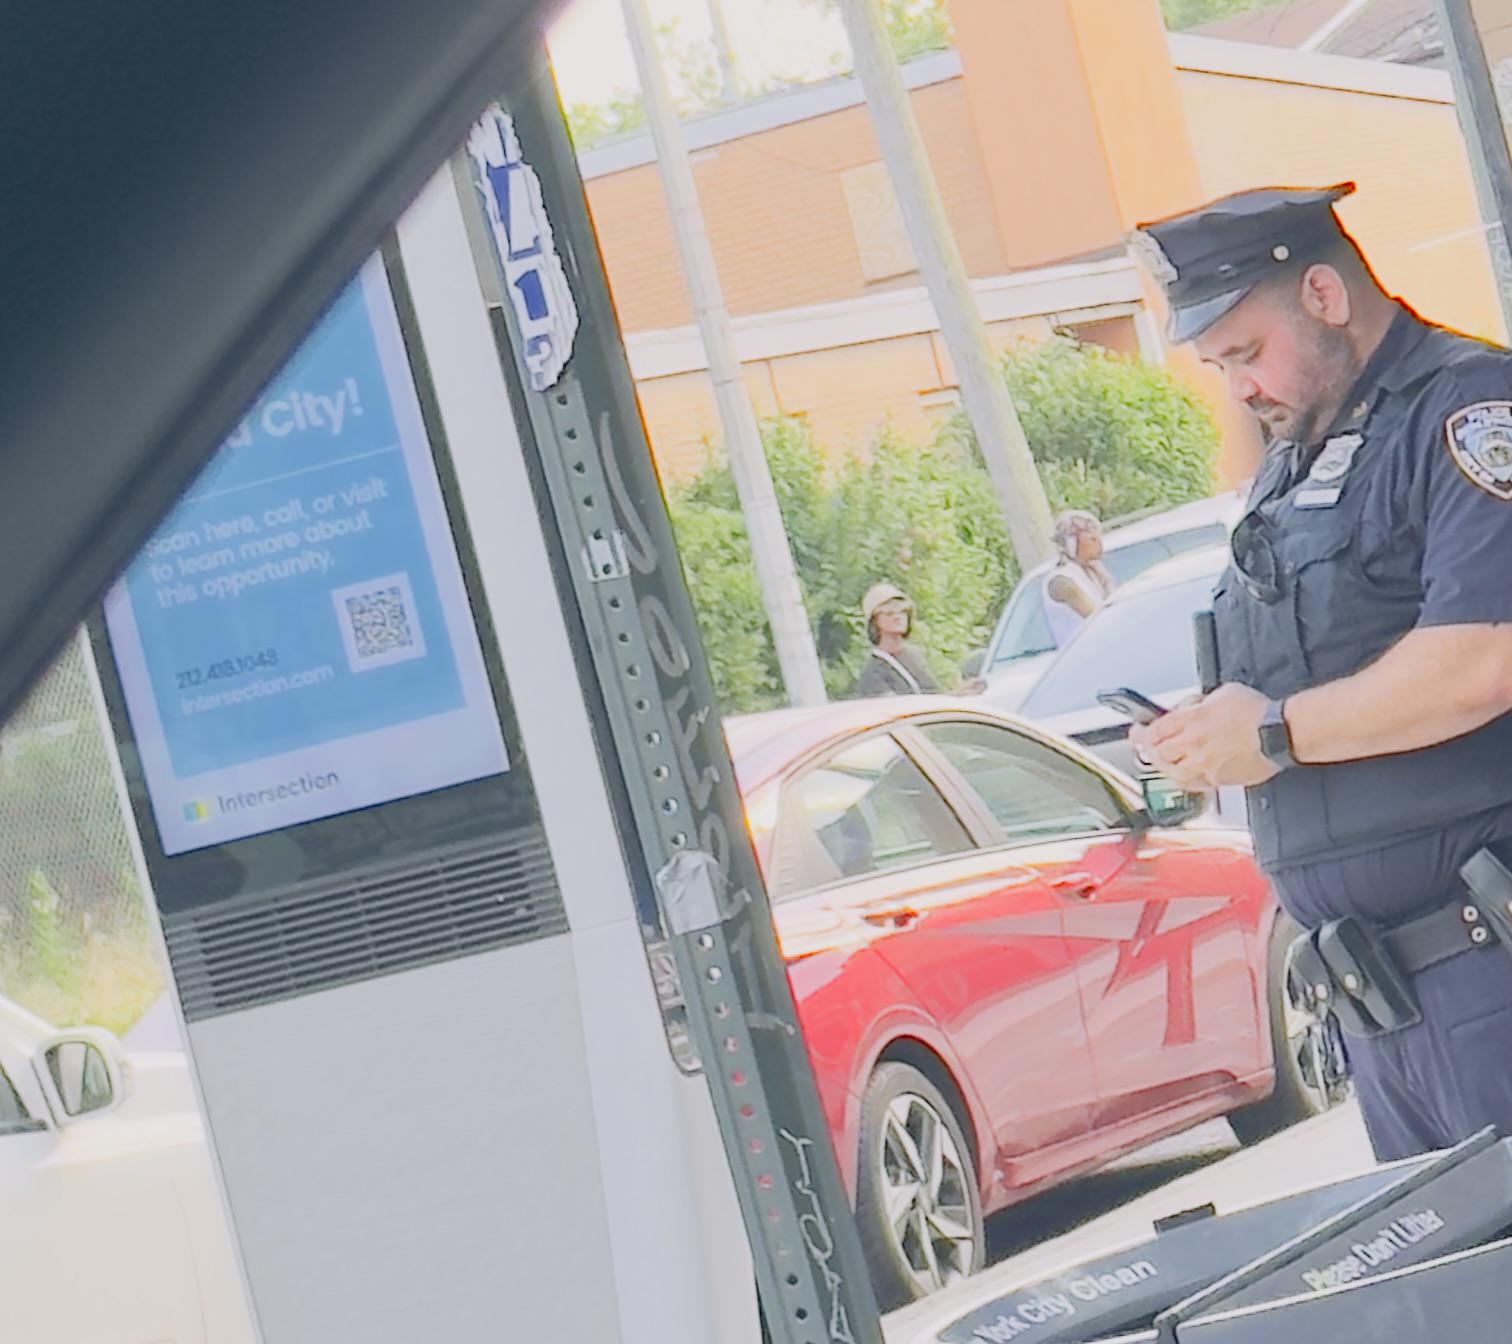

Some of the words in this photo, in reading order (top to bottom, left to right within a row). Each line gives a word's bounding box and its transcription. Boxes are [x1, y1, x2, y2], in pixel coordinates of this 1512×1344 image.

[261, 377, 364, 437] City!
[203, 514, 261, 544] here,
[264, 498, 310, 528] call,
[312, 493, 337, 514] or
[341, 477, 389, 504] visit
[151, 563, 174, 584] to
[177, 546, 236, 577] learn
[240, 531, 300, 558] more
[304, 510, 374, 544] about
[157, 583, 198, 609] this
[202, 549, 336, 600] opportunity.
[217, 770, 340, 815] Intersection
[1301, 1255, 1367, 1292] Please
[1390, 1208, 1446, 1243] Litter
[973, 1314, 1031, 1344] York
[1016, 1293, 1077, 1324] City
[1070, 1260, 1159, 1301] Clean
